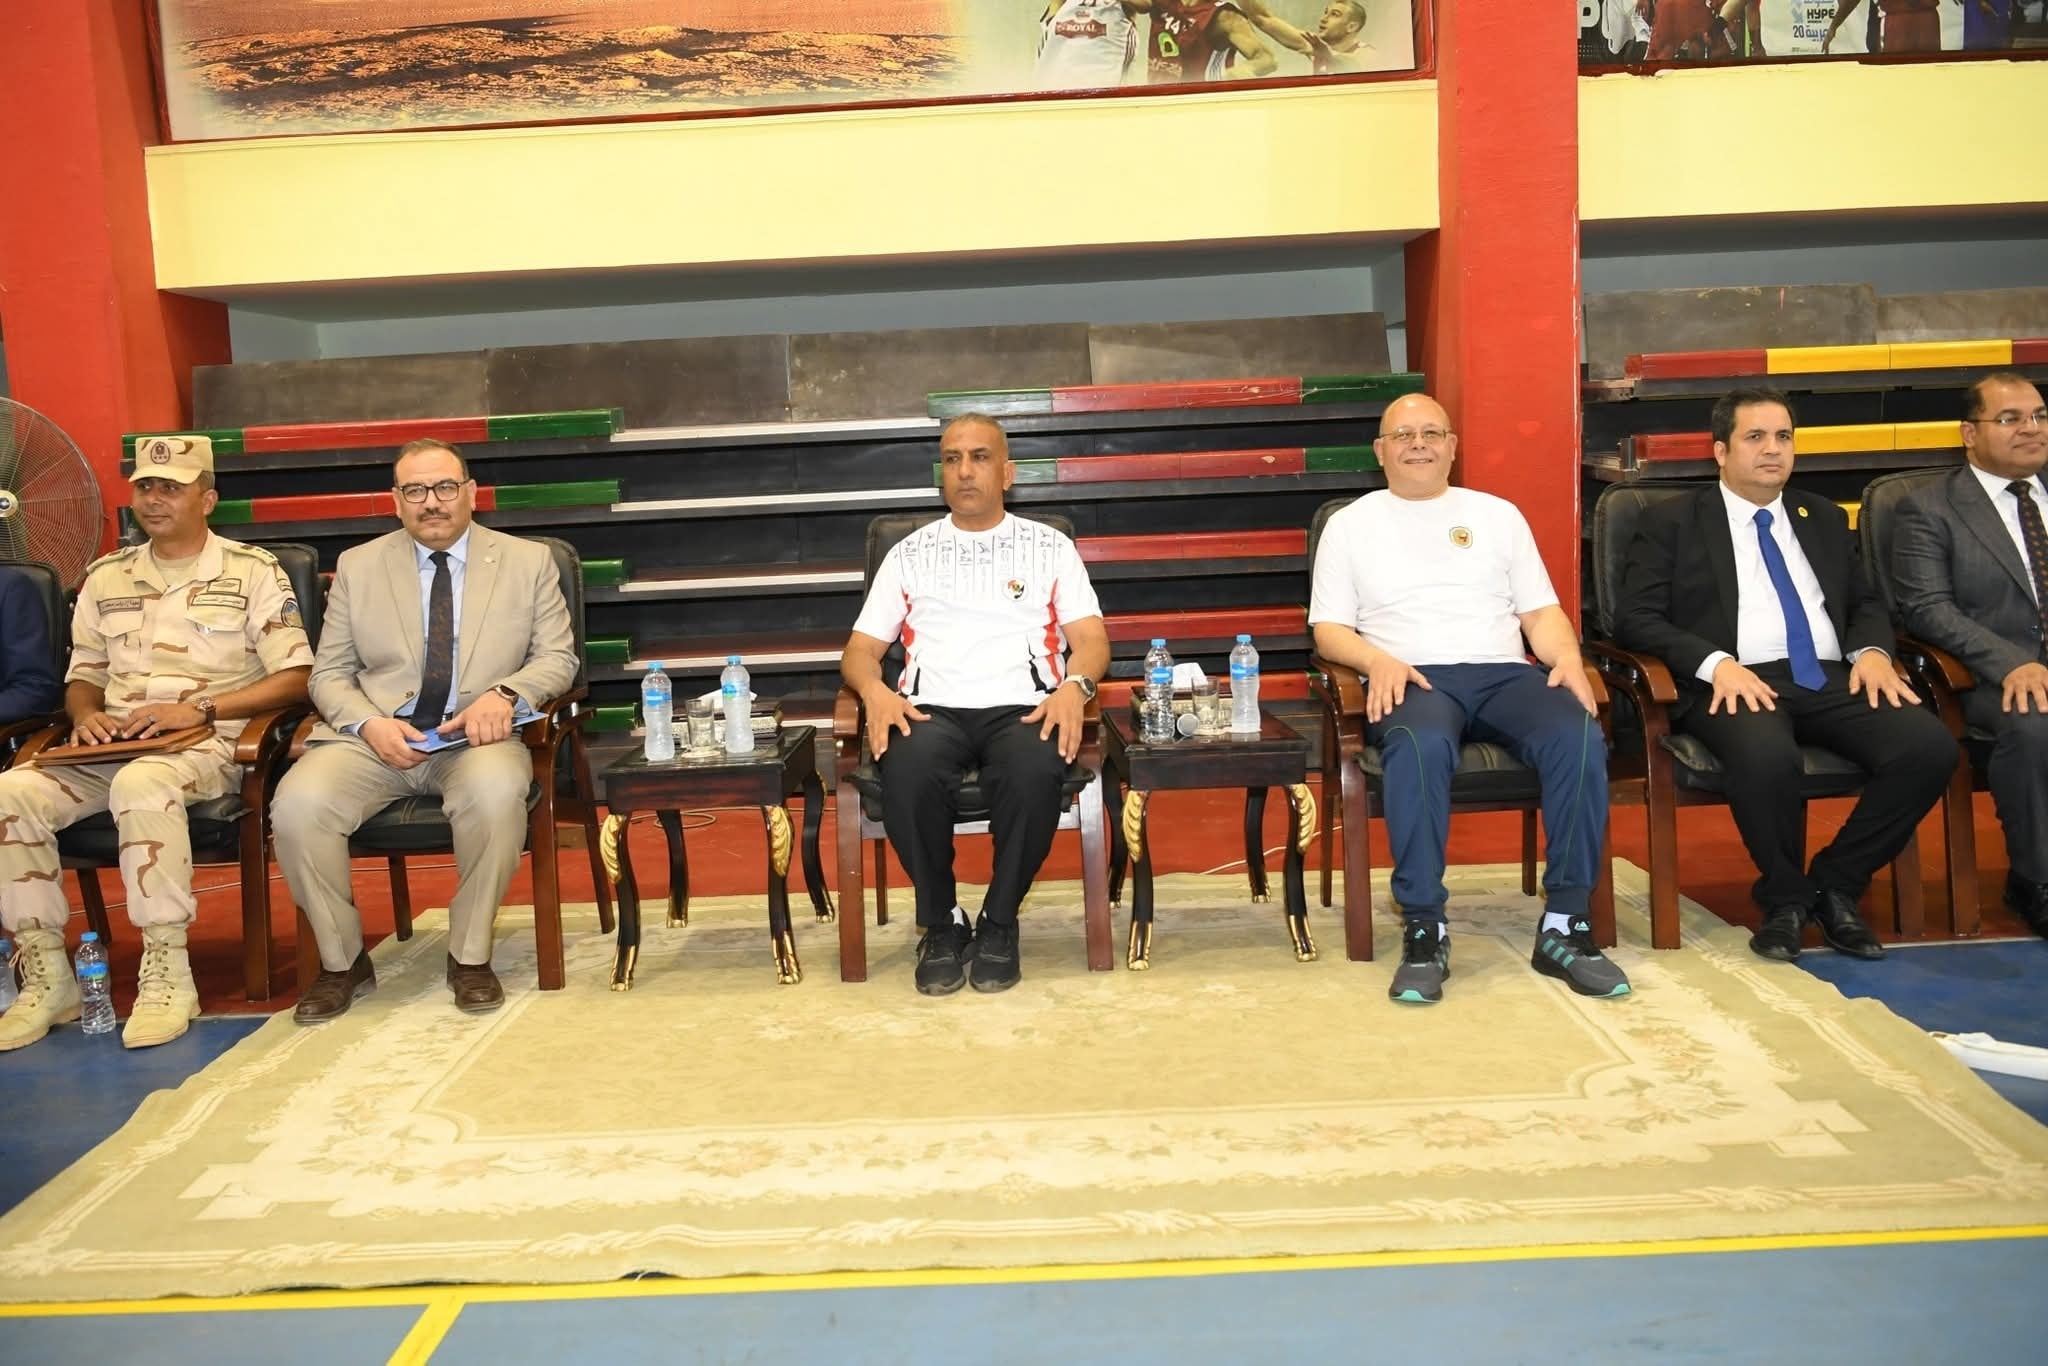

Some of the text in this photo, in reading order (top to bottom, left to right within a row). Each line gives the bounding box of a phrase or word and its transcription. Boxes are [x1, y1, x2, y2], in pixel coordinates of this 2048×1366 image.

[1807, 8, 1835, 19] HYPE
[1067, 23, 1097, 32] ROYAL
[1792, 24, 1804, 38] 20
